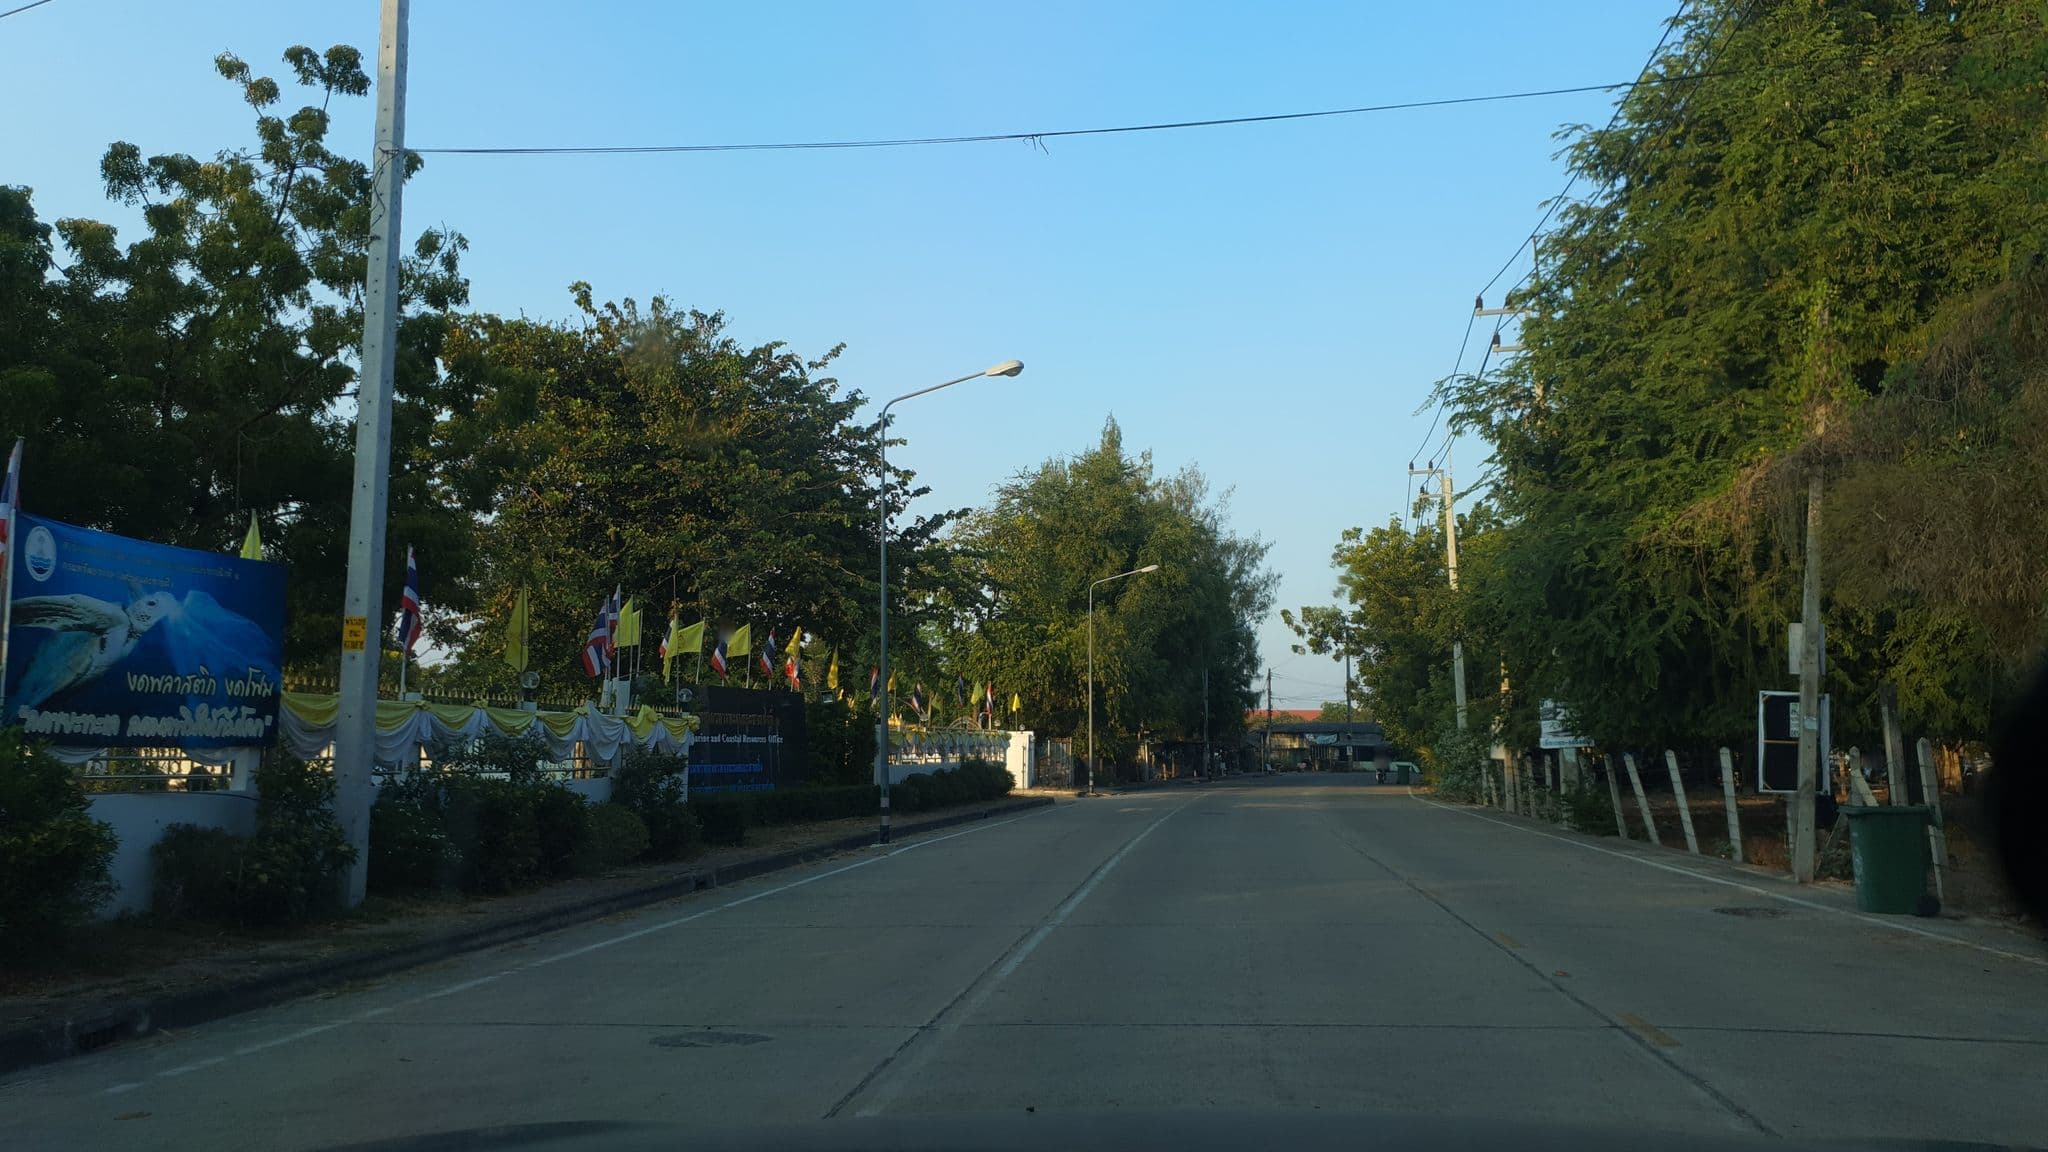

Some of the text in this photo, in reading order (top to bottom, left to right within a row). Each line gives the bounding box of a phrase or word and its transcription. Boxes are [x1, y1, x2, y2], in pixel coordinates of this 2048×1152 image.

[127, 665, 274, 698] งดพลาสติก งดโฟม
